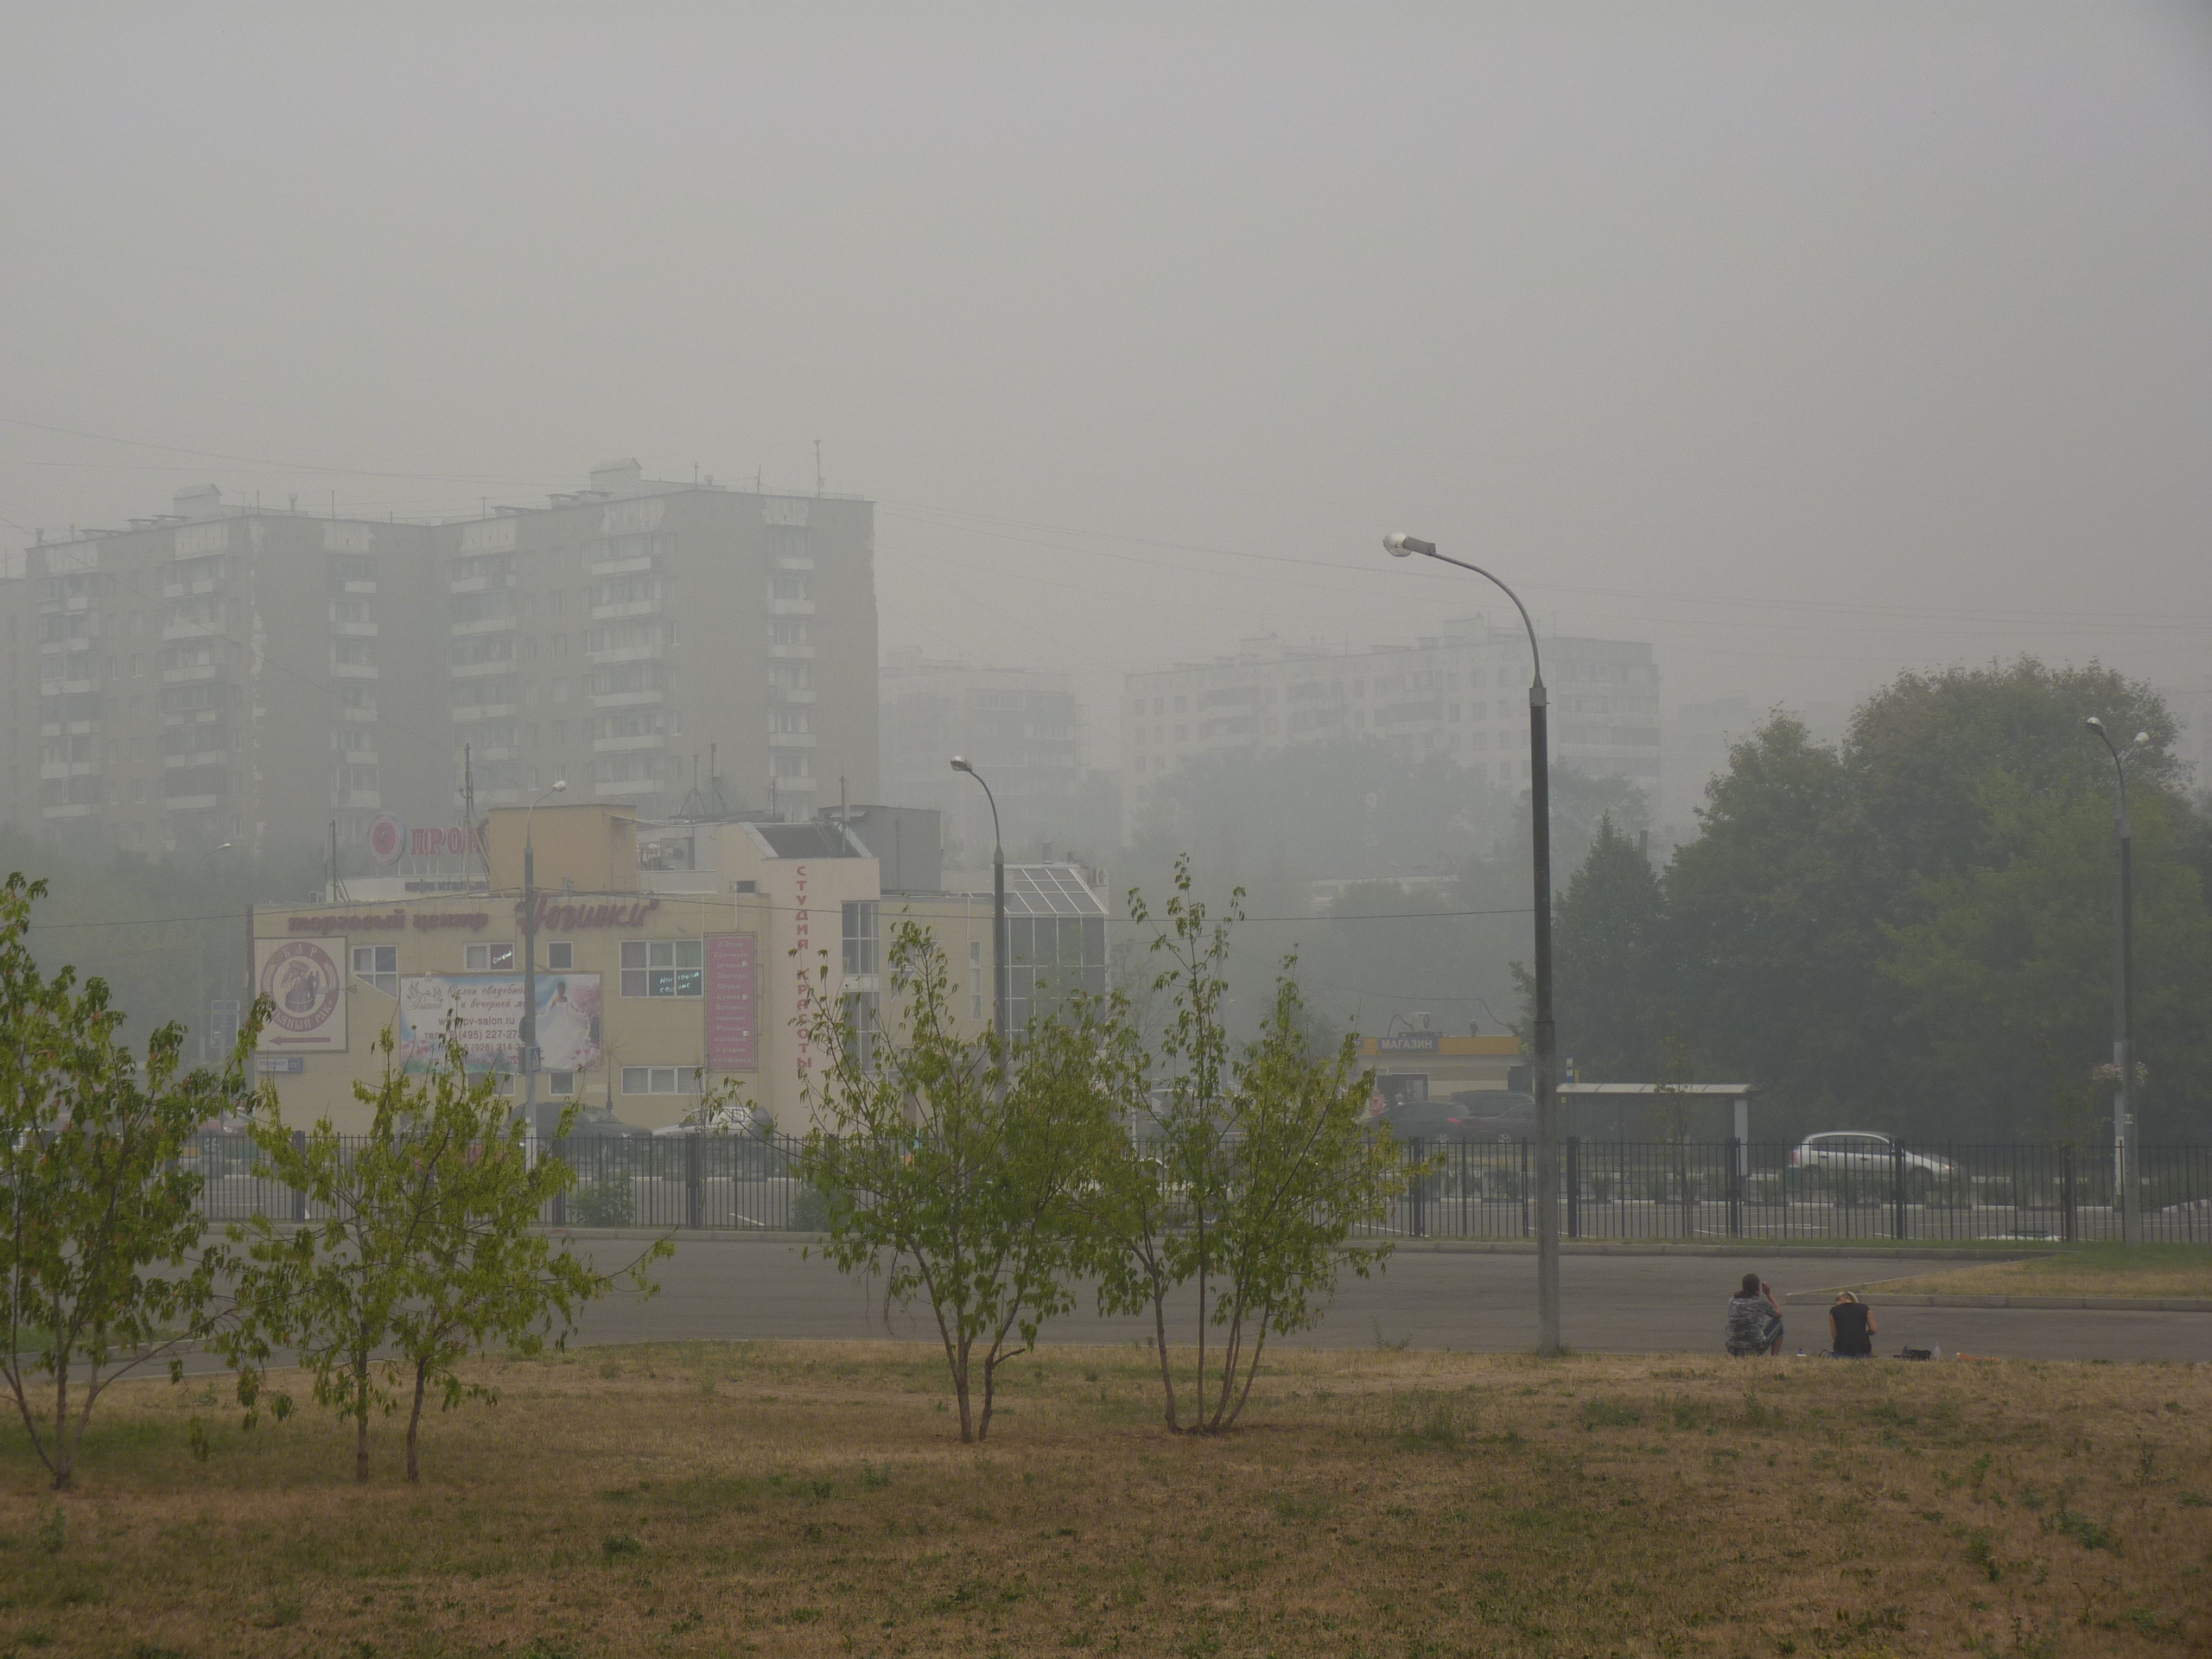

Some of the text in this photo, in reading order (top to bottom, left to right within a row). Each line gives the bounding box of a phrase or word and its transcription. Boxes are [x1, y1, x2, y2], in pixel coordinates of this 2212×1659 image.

[410, 826, 489, 855] ПРОН
[796, 866, 809, 950] СТУДИЯ
[288, 909, 405, 935] торговый
[413, 913, 488, 932] центр
[283, 943, 318, 958] БАР
[481, 983, 525, 999] свадебно
[273, 1010, 312, 1030] ЬЯНЫЙ
[458, 1030, 483, 1041] (495)
[472, 1043, 493, 1053] (926)
[1382, 1039, 1433, 1049] МАГАЗИН
